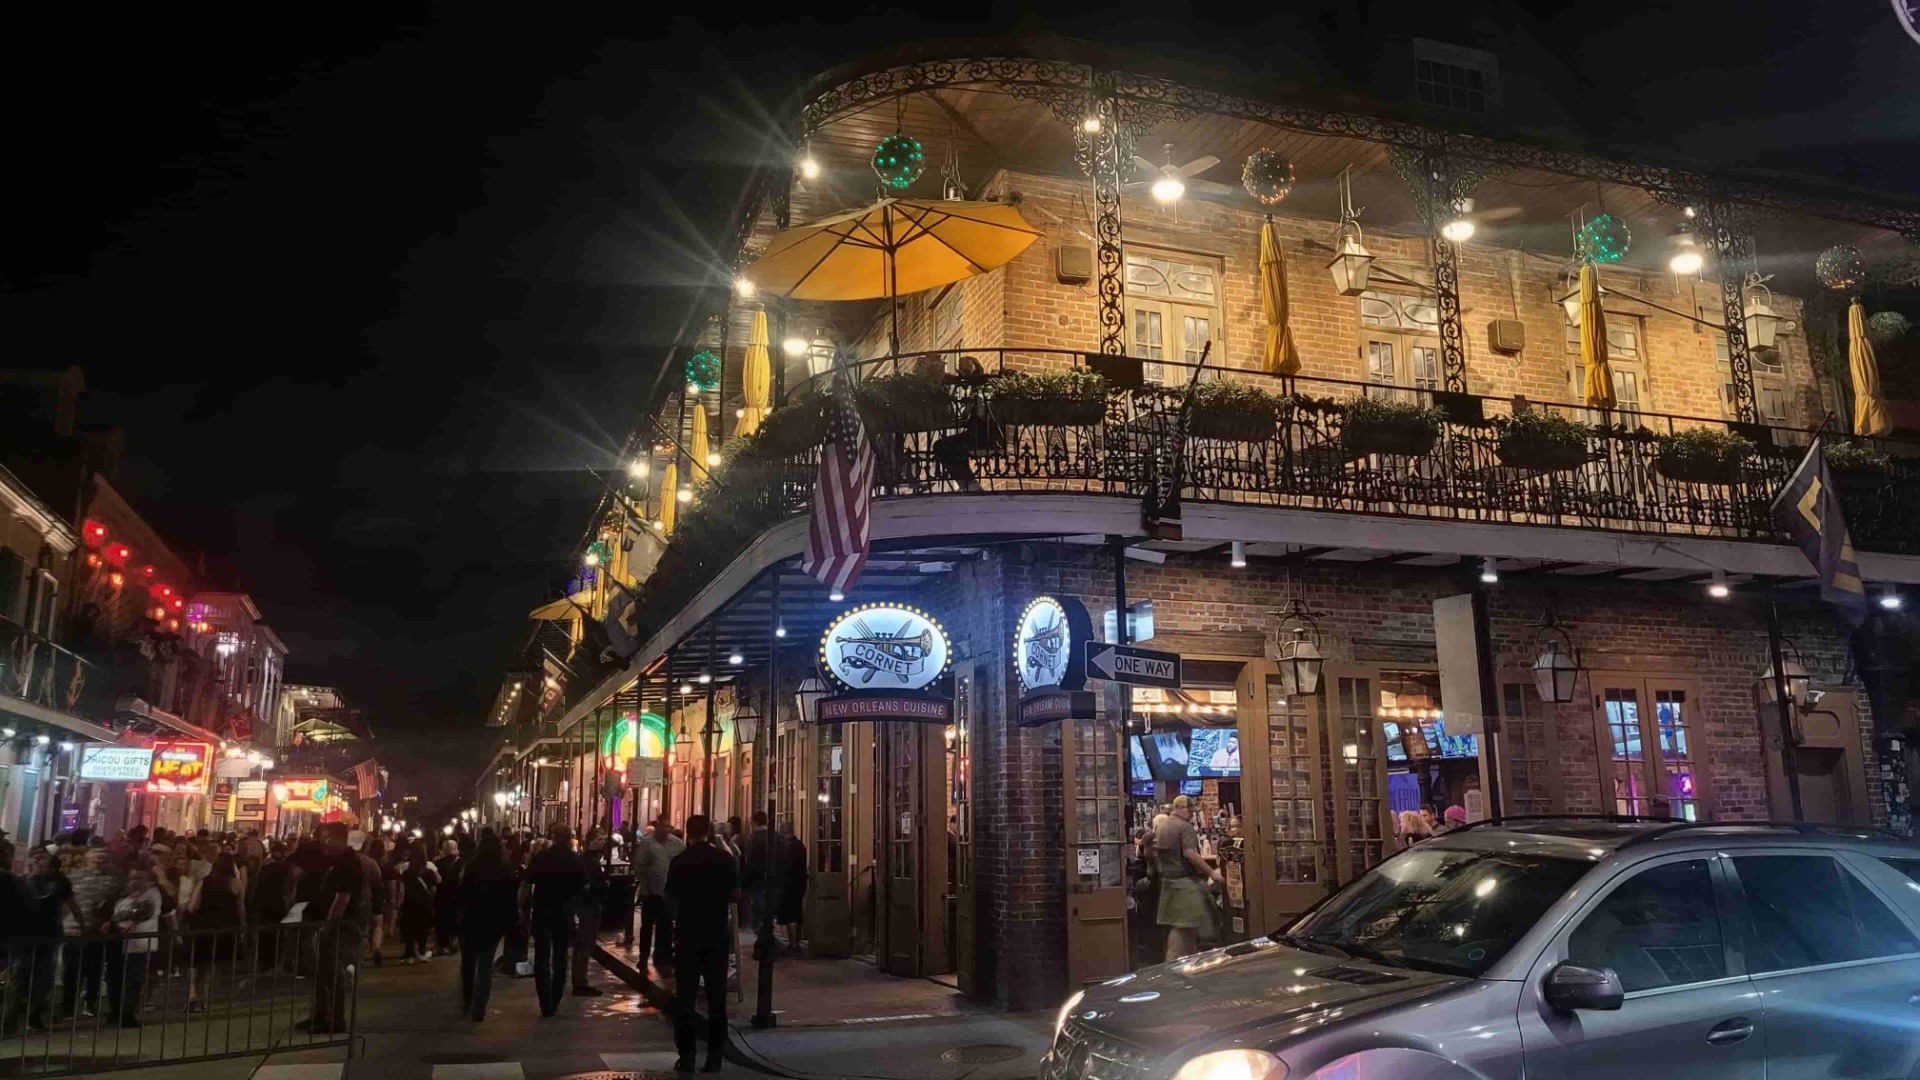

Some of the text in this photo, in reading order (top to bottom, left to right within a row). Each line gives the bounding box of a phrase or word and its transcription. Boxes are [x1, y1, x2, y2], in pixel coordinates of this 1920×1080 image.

[855, 644, 912, 674] CORNET
[1031, 643, 1056, 668] CORNET
[1115, 656, 1172, 677] ONE WAY
[825, 700, 945, 717] NEW ORLEANS CUISINE
[124, 756, 150, 766] GIFTS
